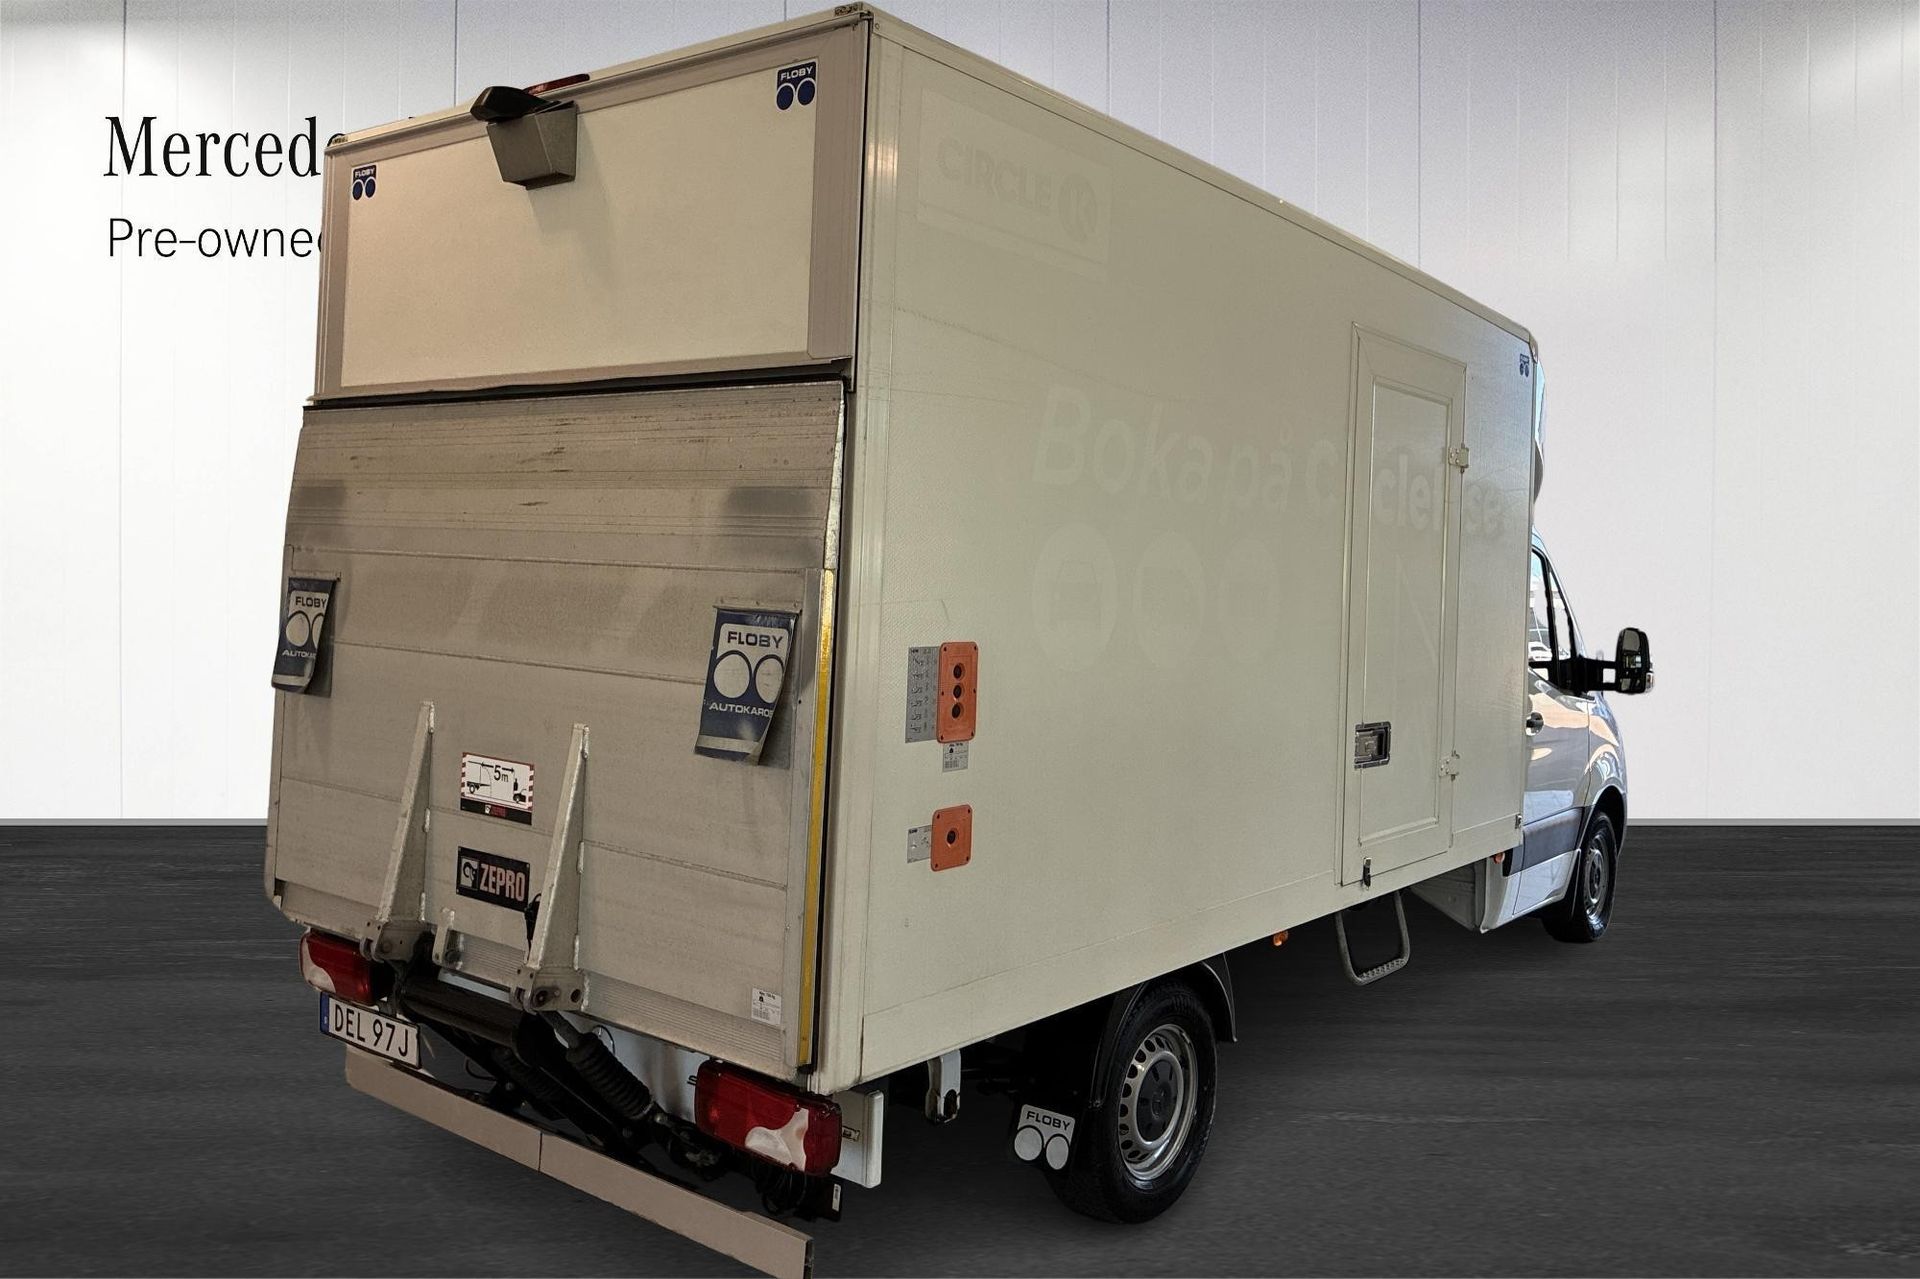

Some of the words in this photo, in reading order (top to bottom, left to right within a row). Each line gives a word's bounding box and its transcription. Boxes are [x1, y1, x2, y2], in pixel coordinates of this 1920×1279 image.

[780, 65, 813, 81] FLOBY
[103, 115, 345, 177] Merced
[354, 167, 375, 179] FLOBY
[936, 137, 1052, 217] CIRCLE
[109, 217, 322, 257] Pre-owne
[295, 596, 327, 608] FLOBY
[727, 631, 783, 649] FLOBY
[479, 863, 526, 902] ZEPRO
[335, 1003, 365, 1043] DEL
[372, 1018, 409, 1057] 97J
[1026, 1110, 1071, 1130] FLOBY
